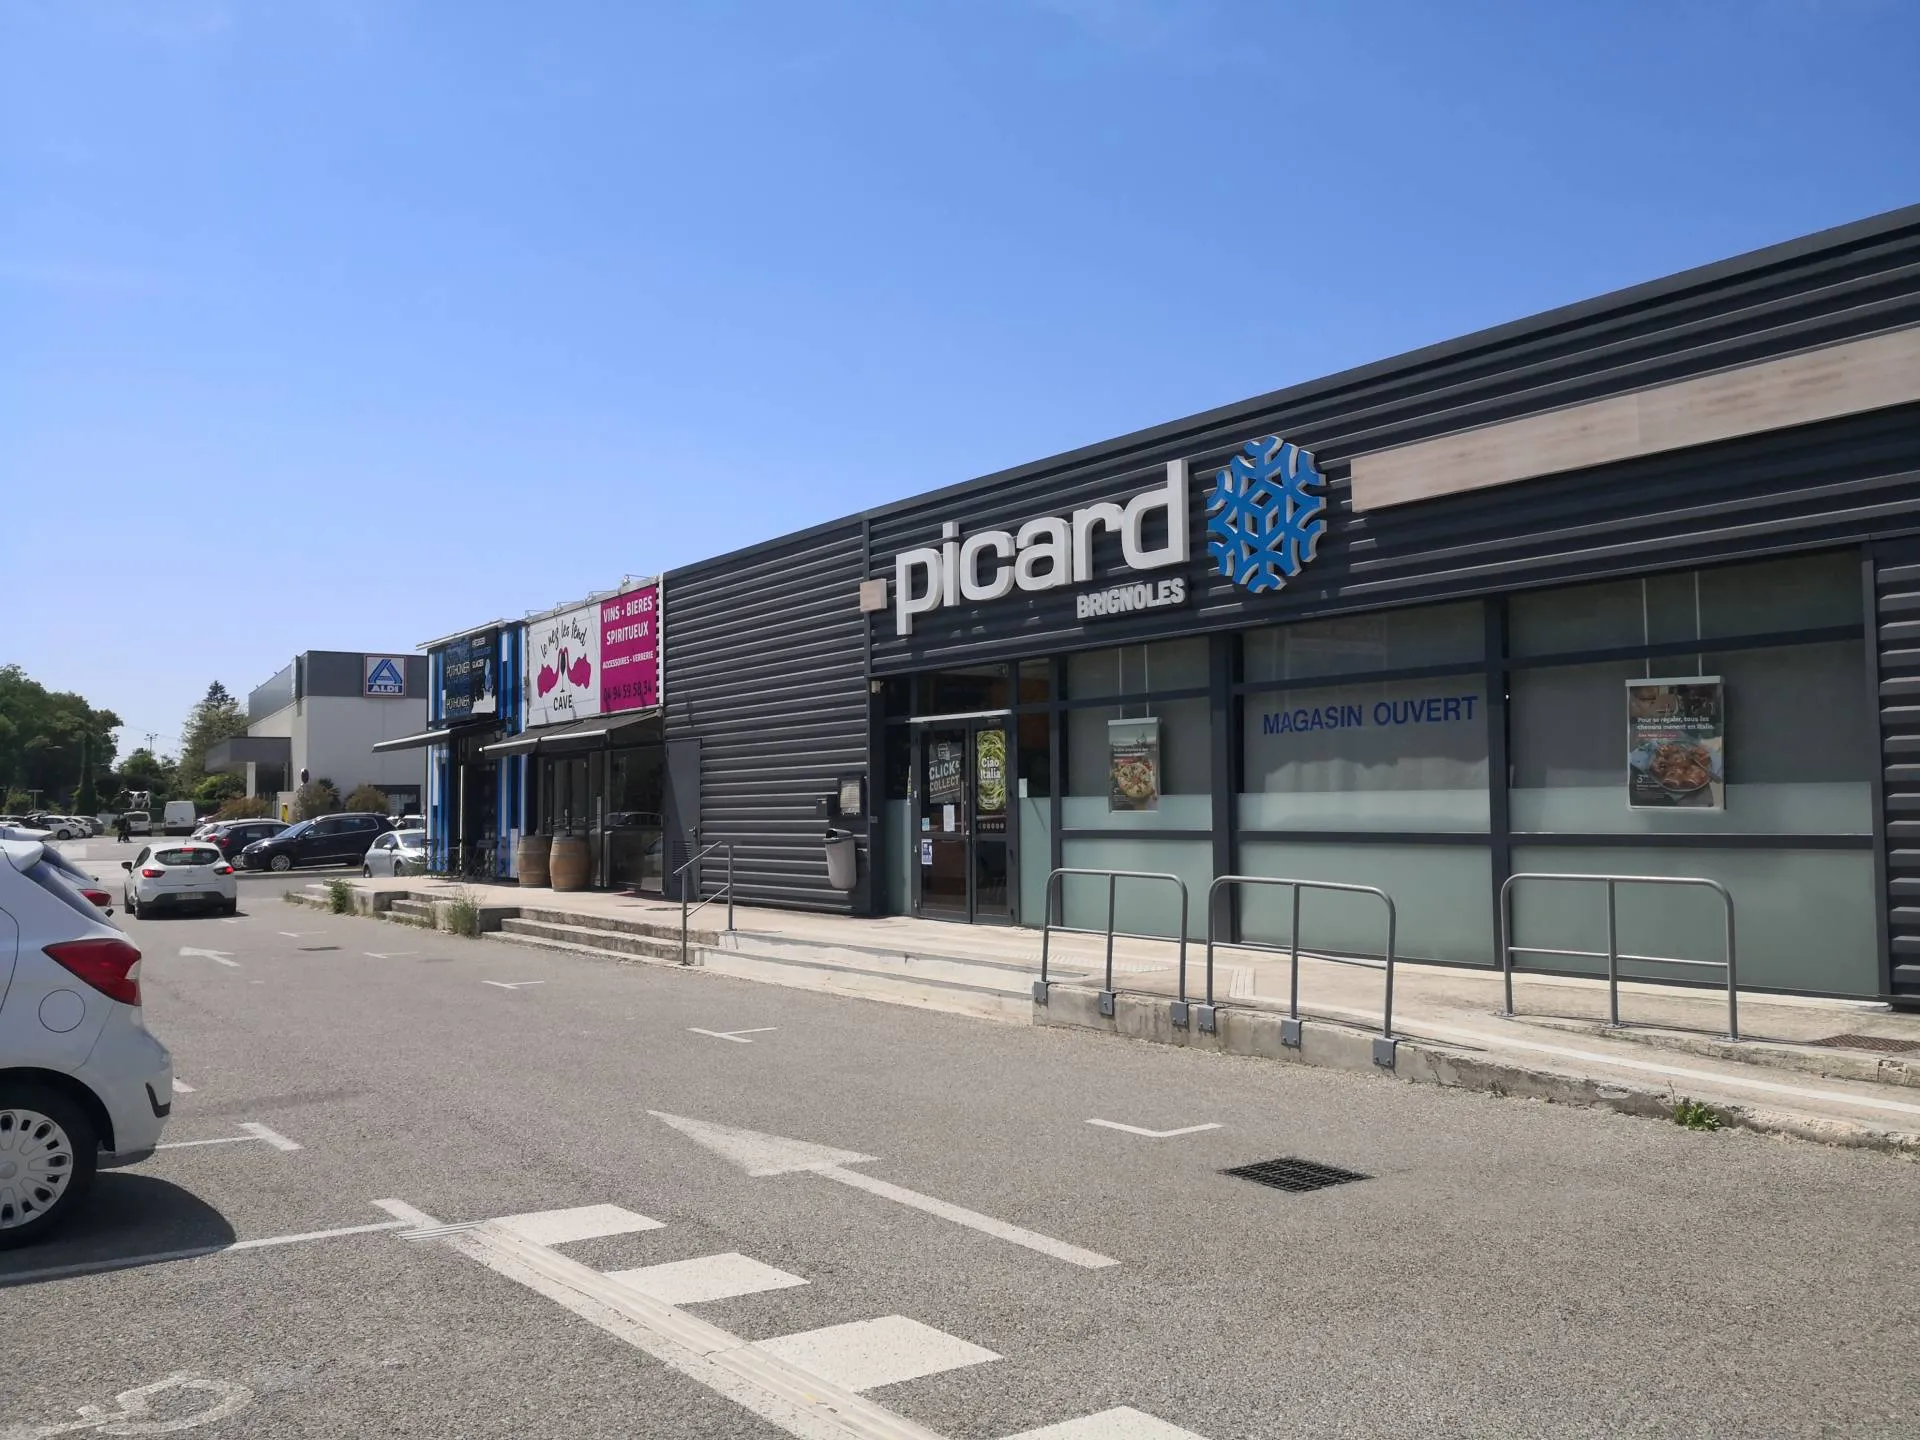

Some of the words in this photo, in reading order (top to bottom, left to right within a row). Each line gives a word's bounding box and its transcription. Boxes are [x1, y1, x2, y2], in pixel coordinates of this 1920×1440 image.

[896, 459, 1190, 635] picard
[603, 606, 620, 623] VINS
[626, 595, 653, 617] BIERES
[1077, 578, 1185, 619] BRIGNOLES
[562, 620, 570, 639] les
[606, 620, 649, 646] SPIRITUEUX
[553, 694, 573, 711] CAVE
[1263, 704, 1363, 735] MAGASIN
[1373, 695, 1478, 726] OUVERT
[981, 756, 1000, 768] Ciao
[930, 775, 960, 792] COLLECT
[980, 768, 1001, 780] Italia
